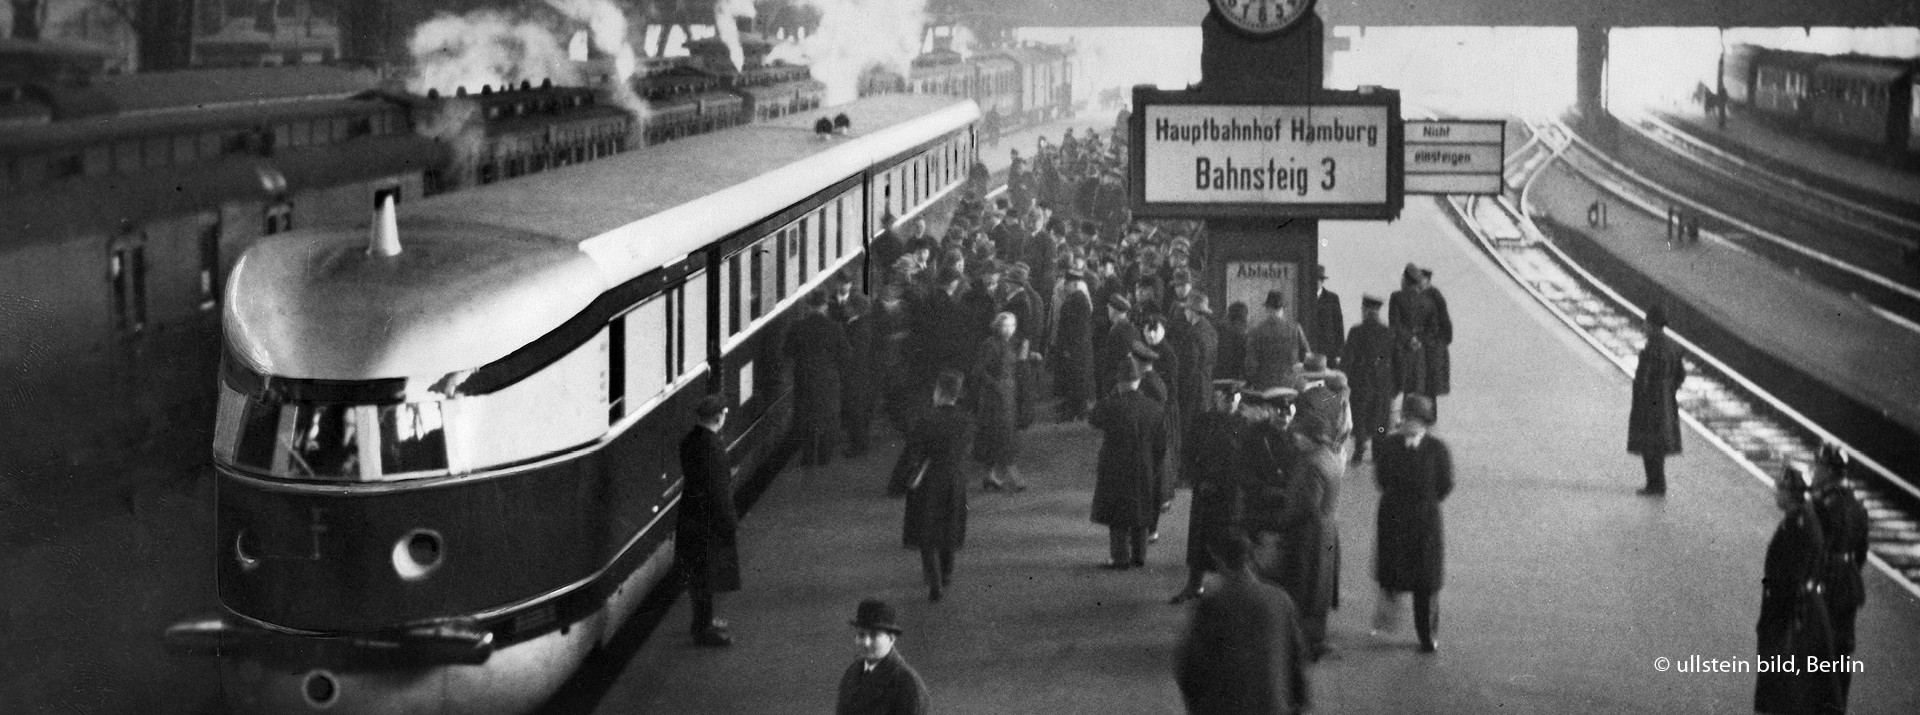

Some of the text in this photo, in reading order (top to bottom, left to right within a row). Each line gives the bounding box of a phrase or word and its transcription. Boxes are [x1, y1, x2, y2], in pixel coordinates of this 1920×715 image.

[1156, 117, 1378, 147] Hauptbahnhof Hamburg
[1423, 126, 1450, 137] Nicht
[1414, 151, 1471, 166] einsteigen
[1195, 157, 1336, 196] Bahnsteig 3
